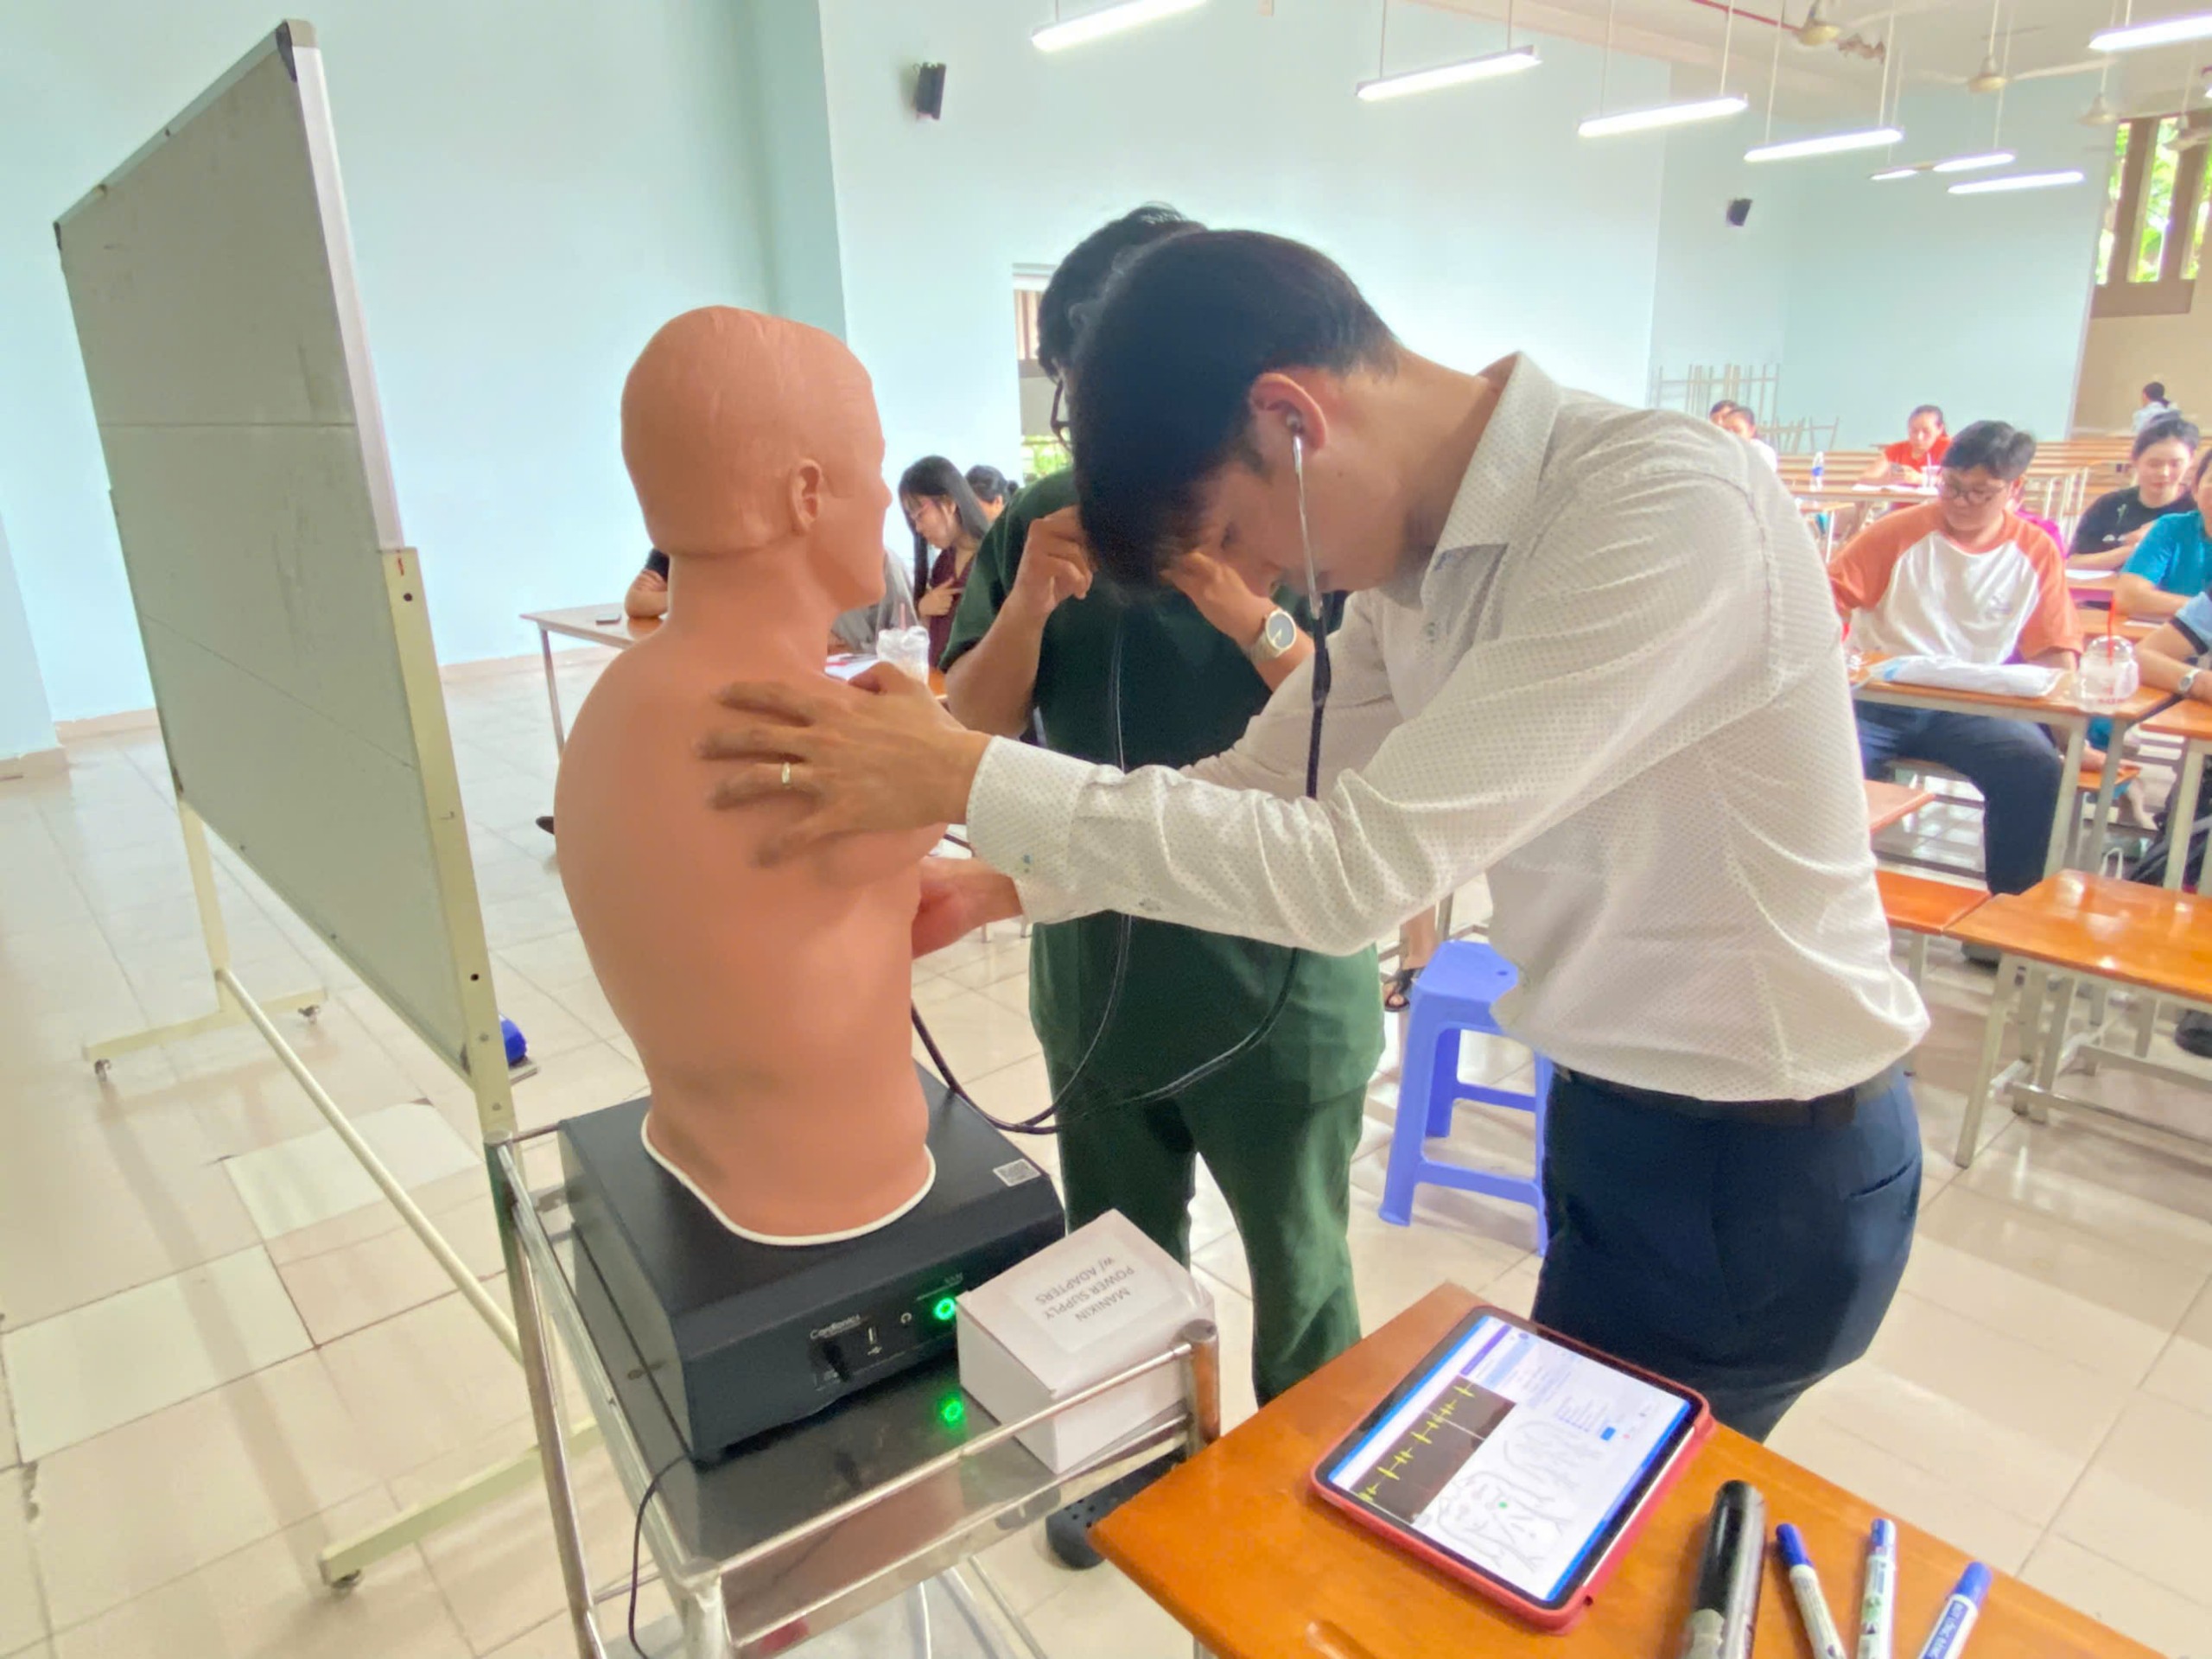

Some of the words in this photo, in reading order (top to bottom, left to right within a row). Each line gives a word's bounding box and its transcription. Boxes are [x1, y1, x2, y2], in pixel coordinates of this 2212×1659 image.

[1035, 1267, 1096, 1304] ADAPTERS
[1089, 1265, 1135, 1295] POWER
[1044, 1290, 1090, 1320] SUPPLY
[1074, 1287, 1131, 1321] MANIKIN
